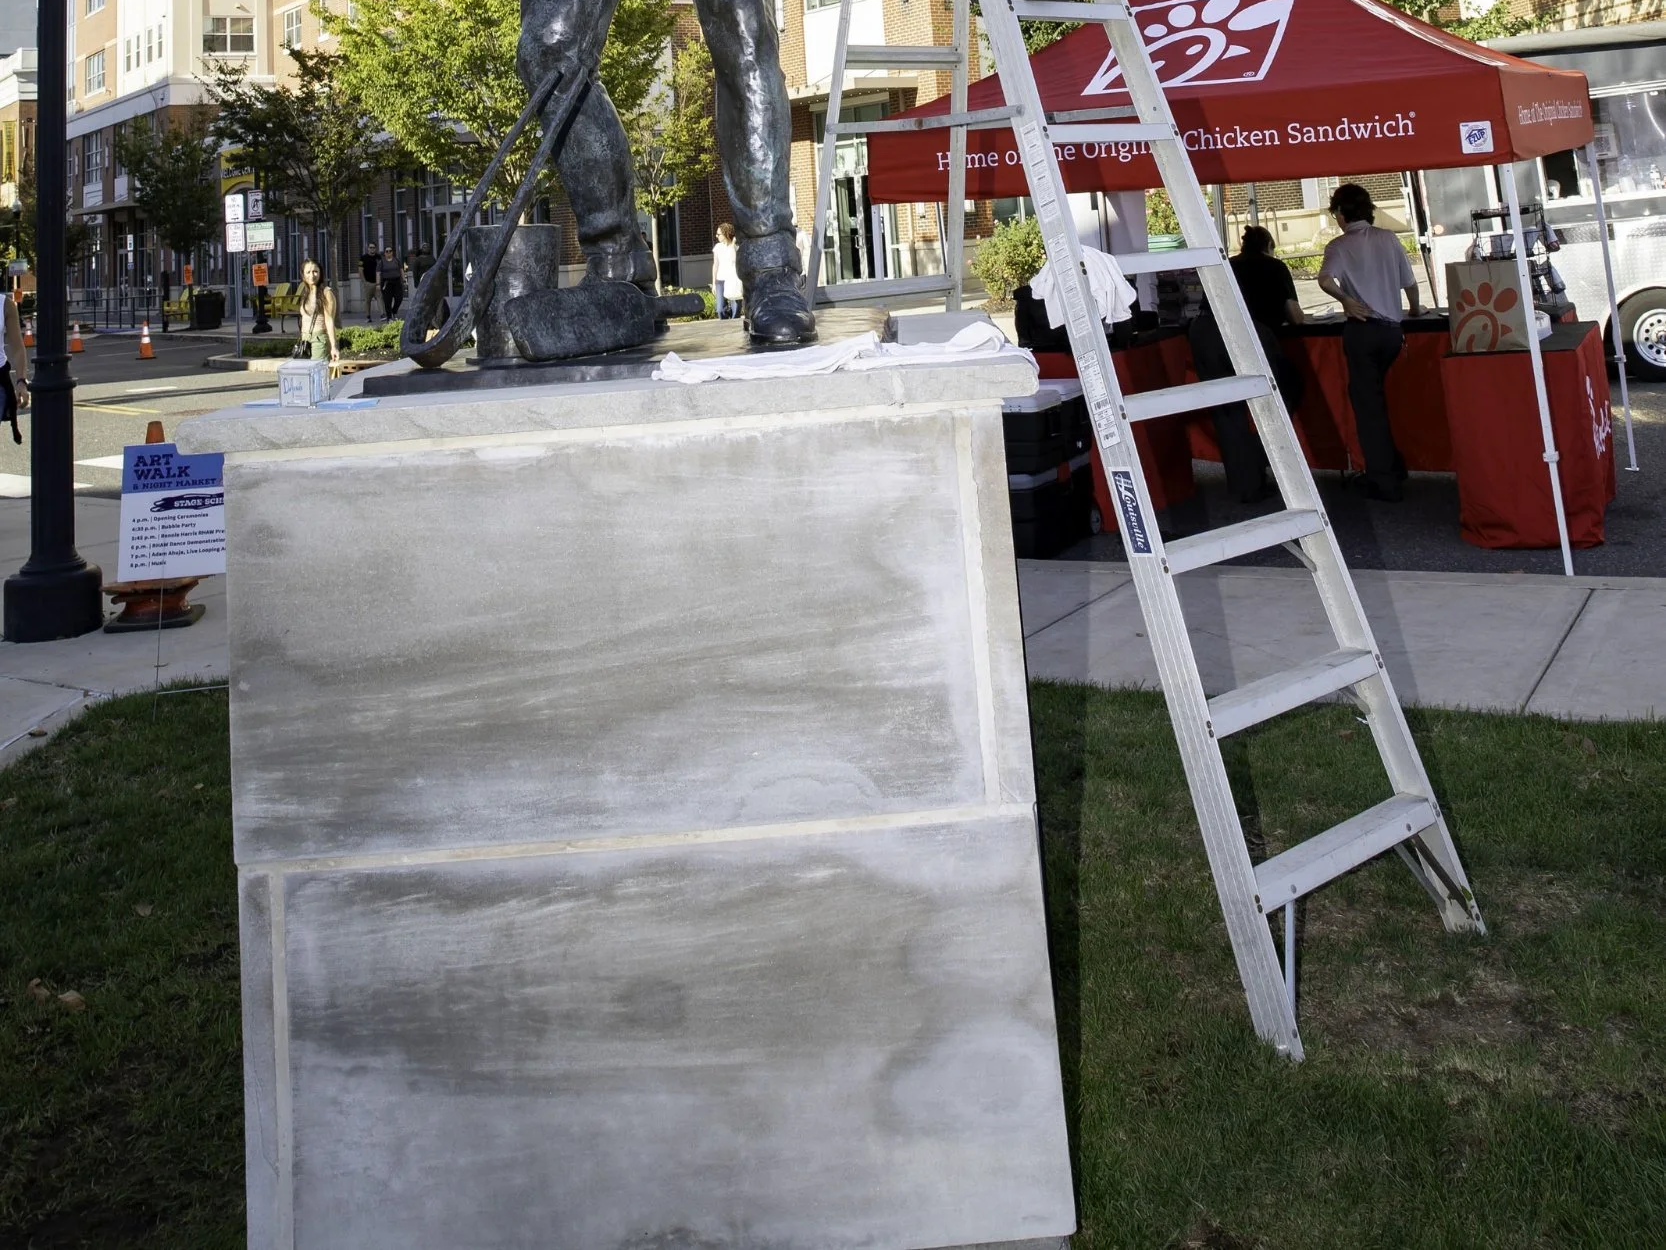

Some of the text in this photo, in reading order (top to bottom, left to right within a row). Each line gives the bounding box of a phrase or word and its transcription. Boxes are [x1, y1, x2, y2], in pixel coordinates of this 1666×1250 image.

[936, 151, 999, 171] Hme
[1183, 126, 1280, 151] Chicken
[134, 453, 173, 467] ART
[133, 465, 190, 481] WALK
[142, 481, 173, 490] NIGHT
[176, 478, 217, 487] MARKET
[174, 496, 224, 507] STAGE SCH
